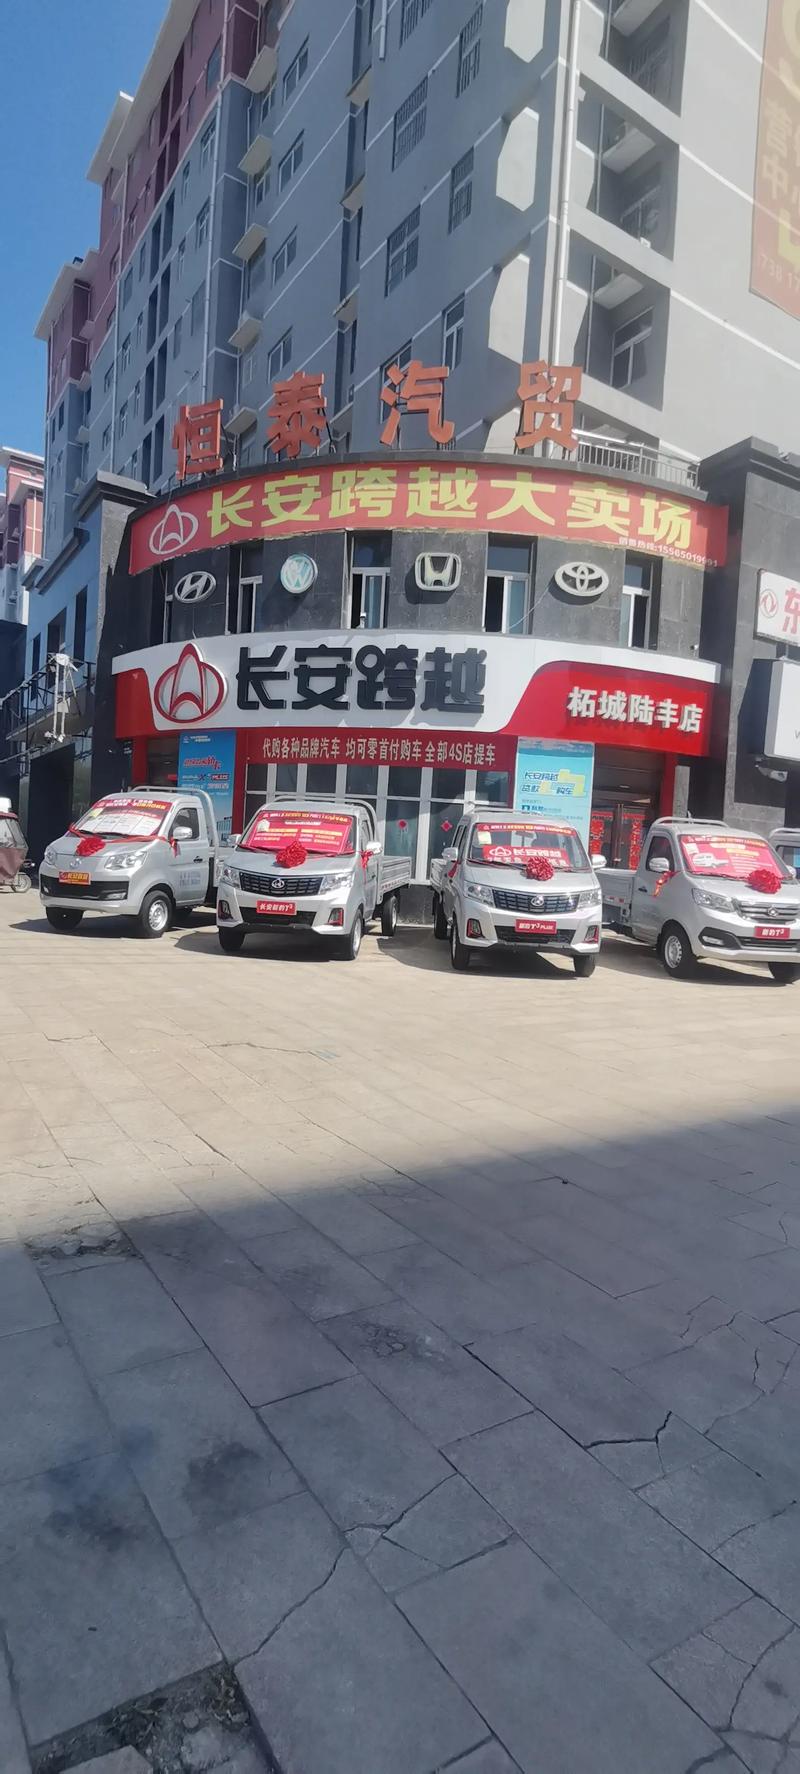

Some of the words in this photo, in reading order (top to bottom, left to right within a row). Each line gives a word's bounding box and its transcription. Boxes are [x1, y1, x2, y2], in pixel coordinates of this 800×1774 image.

[172, 360, 583, 480] 恒泰汽贸
[207, 466, 692, 549] 长安跨越大卖场
[236, 644, 488, 714] 长安跨越
[567, 686, 703, 733] 柘城陆丰店
[262, 737, 341, 759] 代购各种品牌汽车
[345, 738, 422, 762] 均可零首付购车
[424, 740, 496, 766] 全部4S店提车
